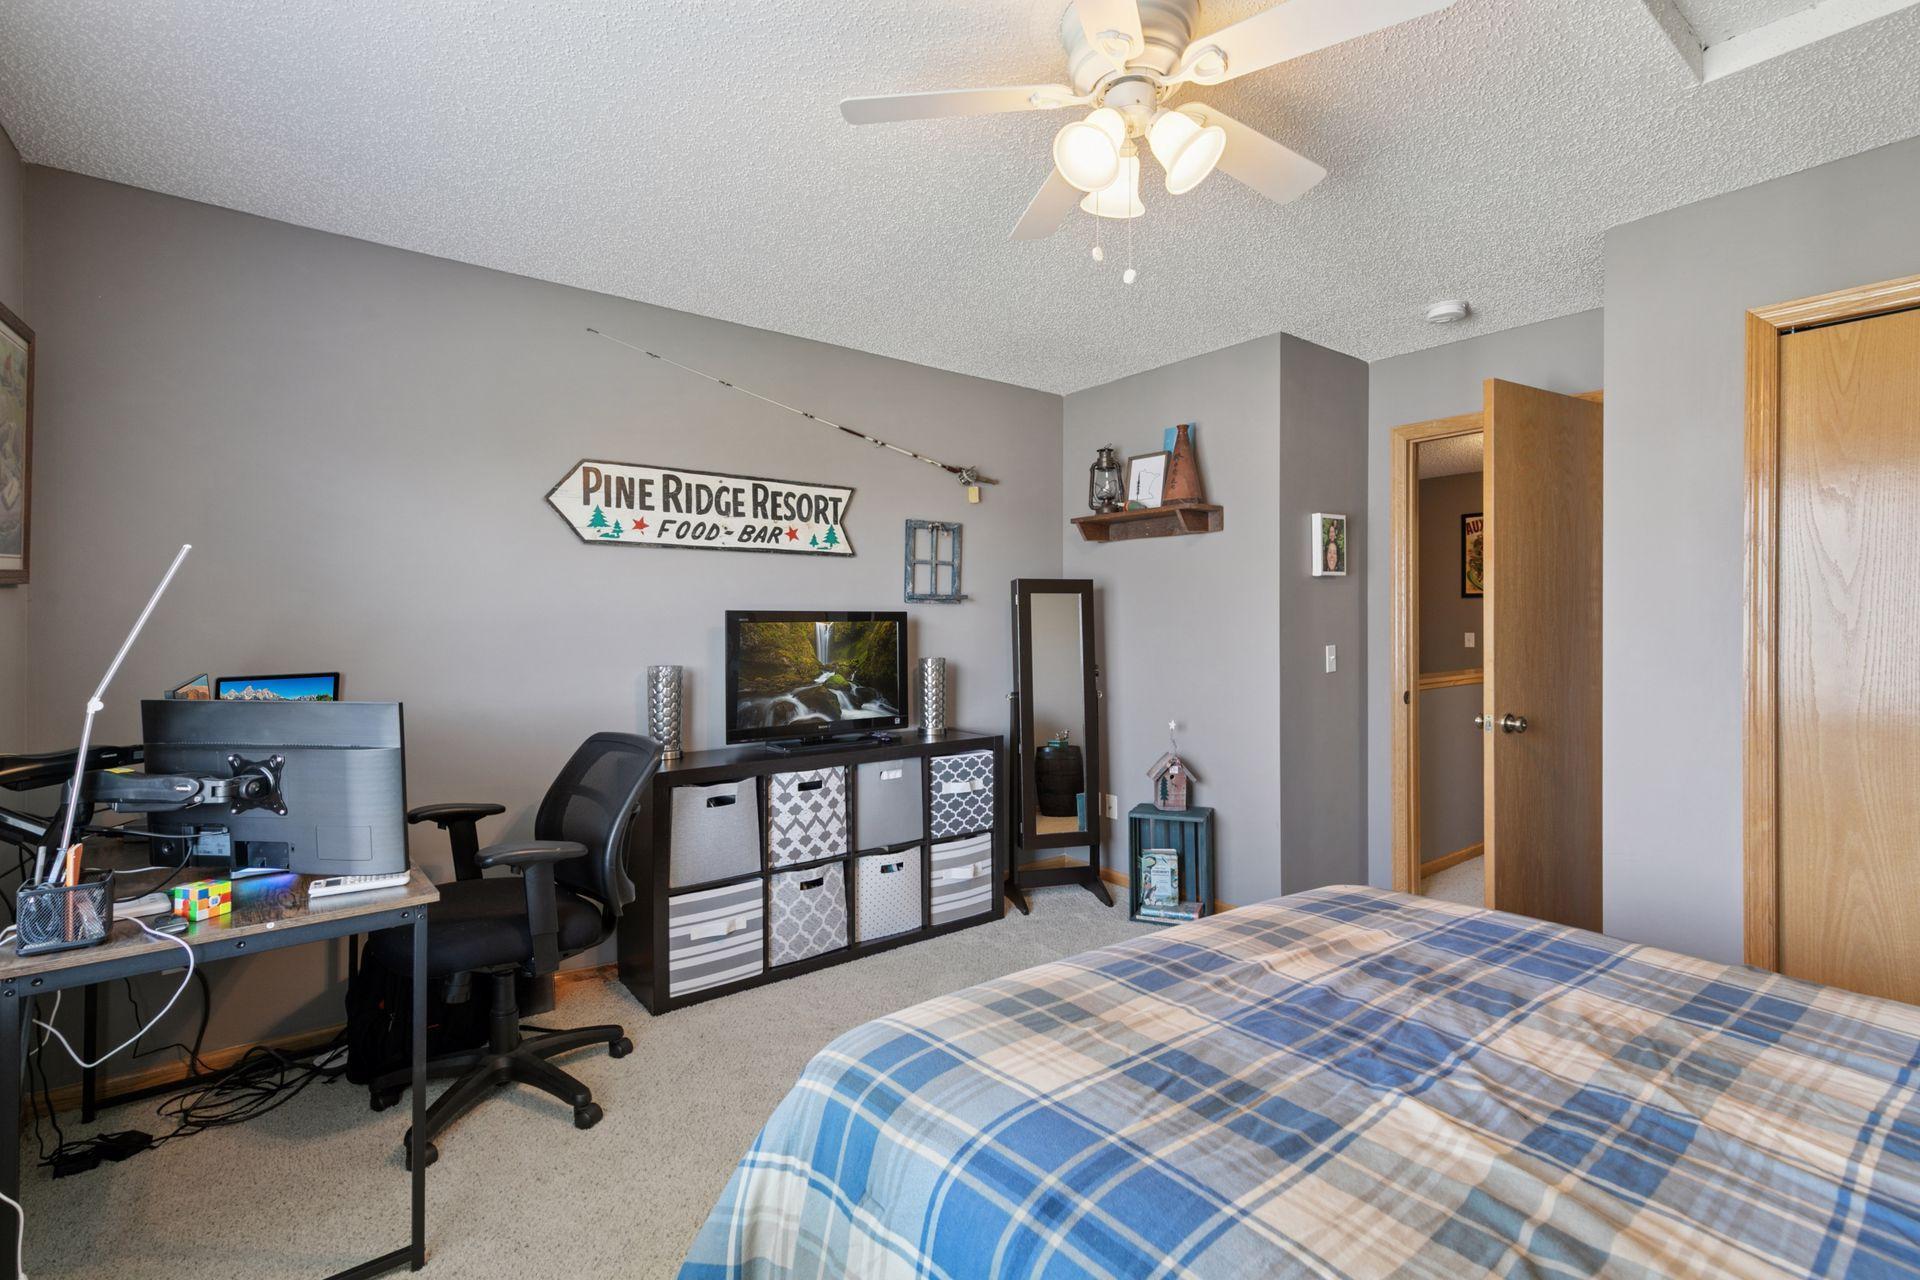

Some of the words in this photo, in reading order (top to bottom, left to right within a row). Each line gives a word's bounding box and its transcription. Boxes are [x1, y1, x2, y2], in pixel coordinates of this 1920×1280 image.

[582, 466, 655, 511] PINE
[662, 473, 746, 518] RIDGE
[752, 483, 842, 525] RESORT
[657, 519, 720, 541] FOOD
[737, 525, 784, 544] BAR
